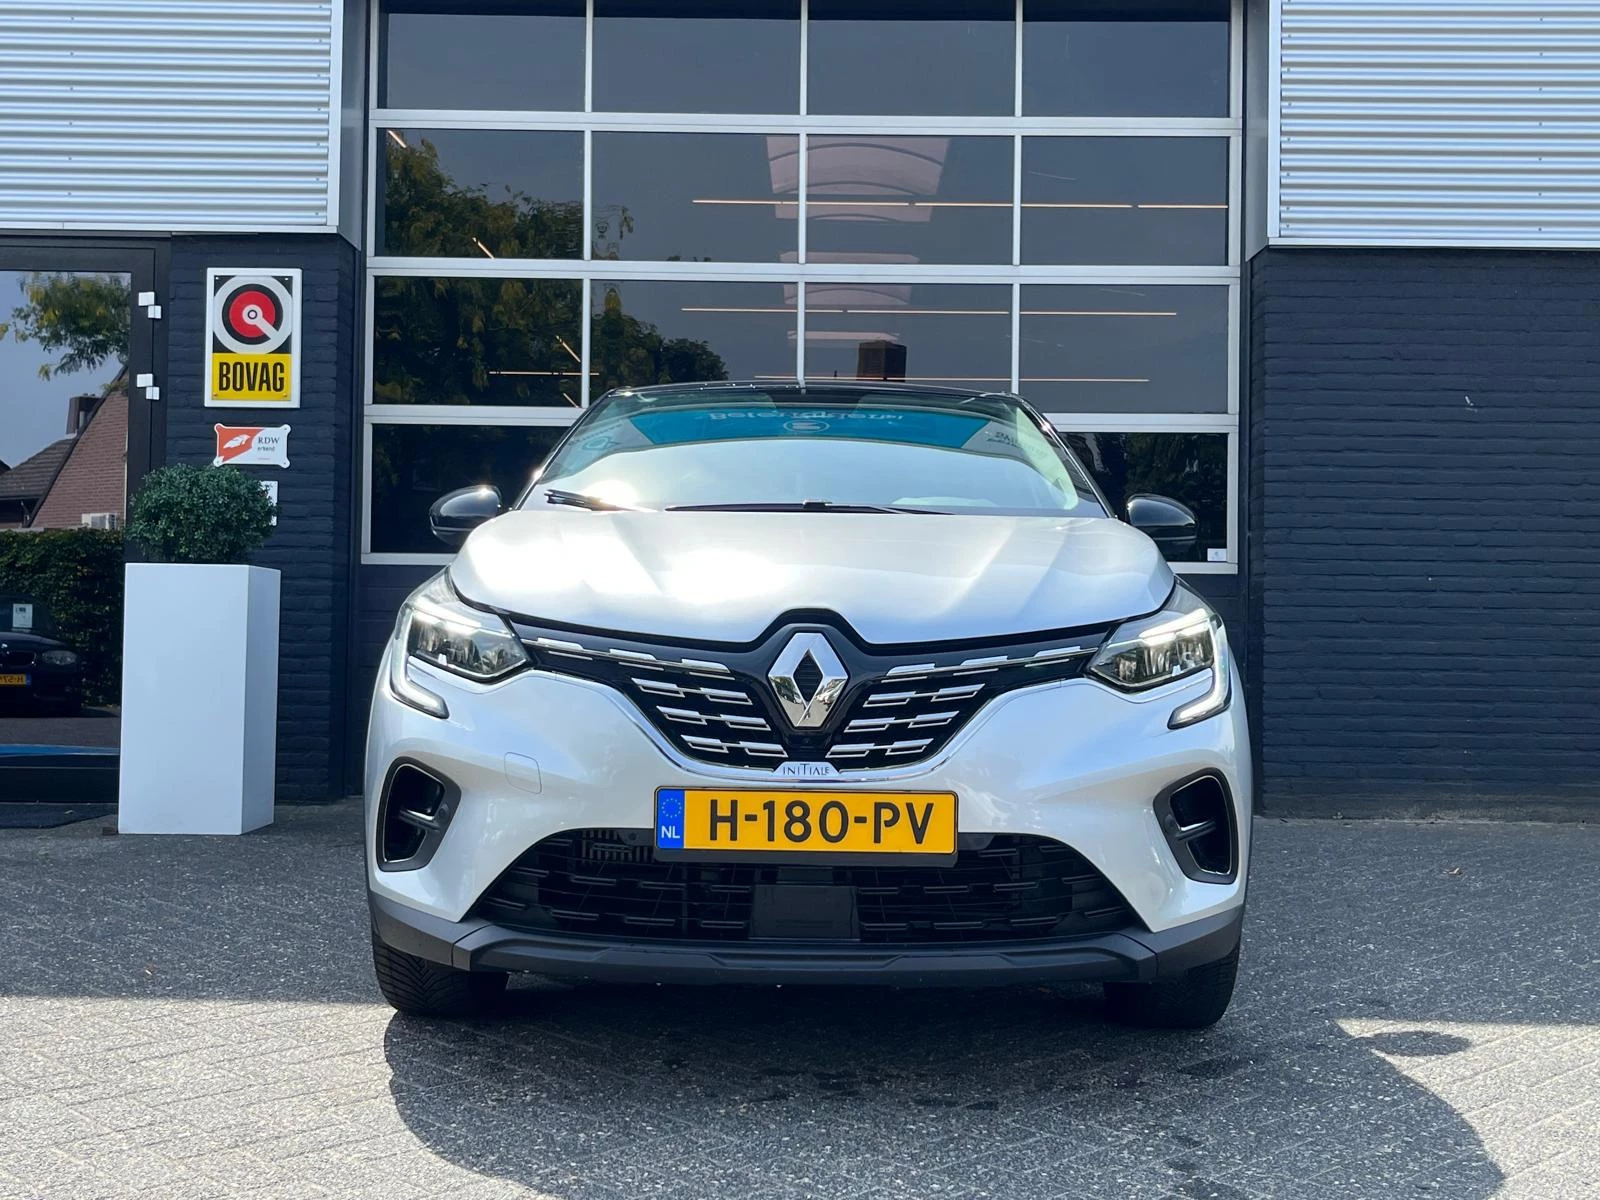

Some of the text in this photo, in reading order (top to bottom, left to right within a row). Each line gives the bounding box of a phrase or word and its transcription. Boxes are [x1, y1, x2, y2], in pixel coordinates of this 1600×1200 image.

[219, 362, 285, 392] BOVAG
[783, 762, 830, 776] INITIALE
[661, 825, 681, 839] NL
[709, 799, 935, 845] H-180-PV
